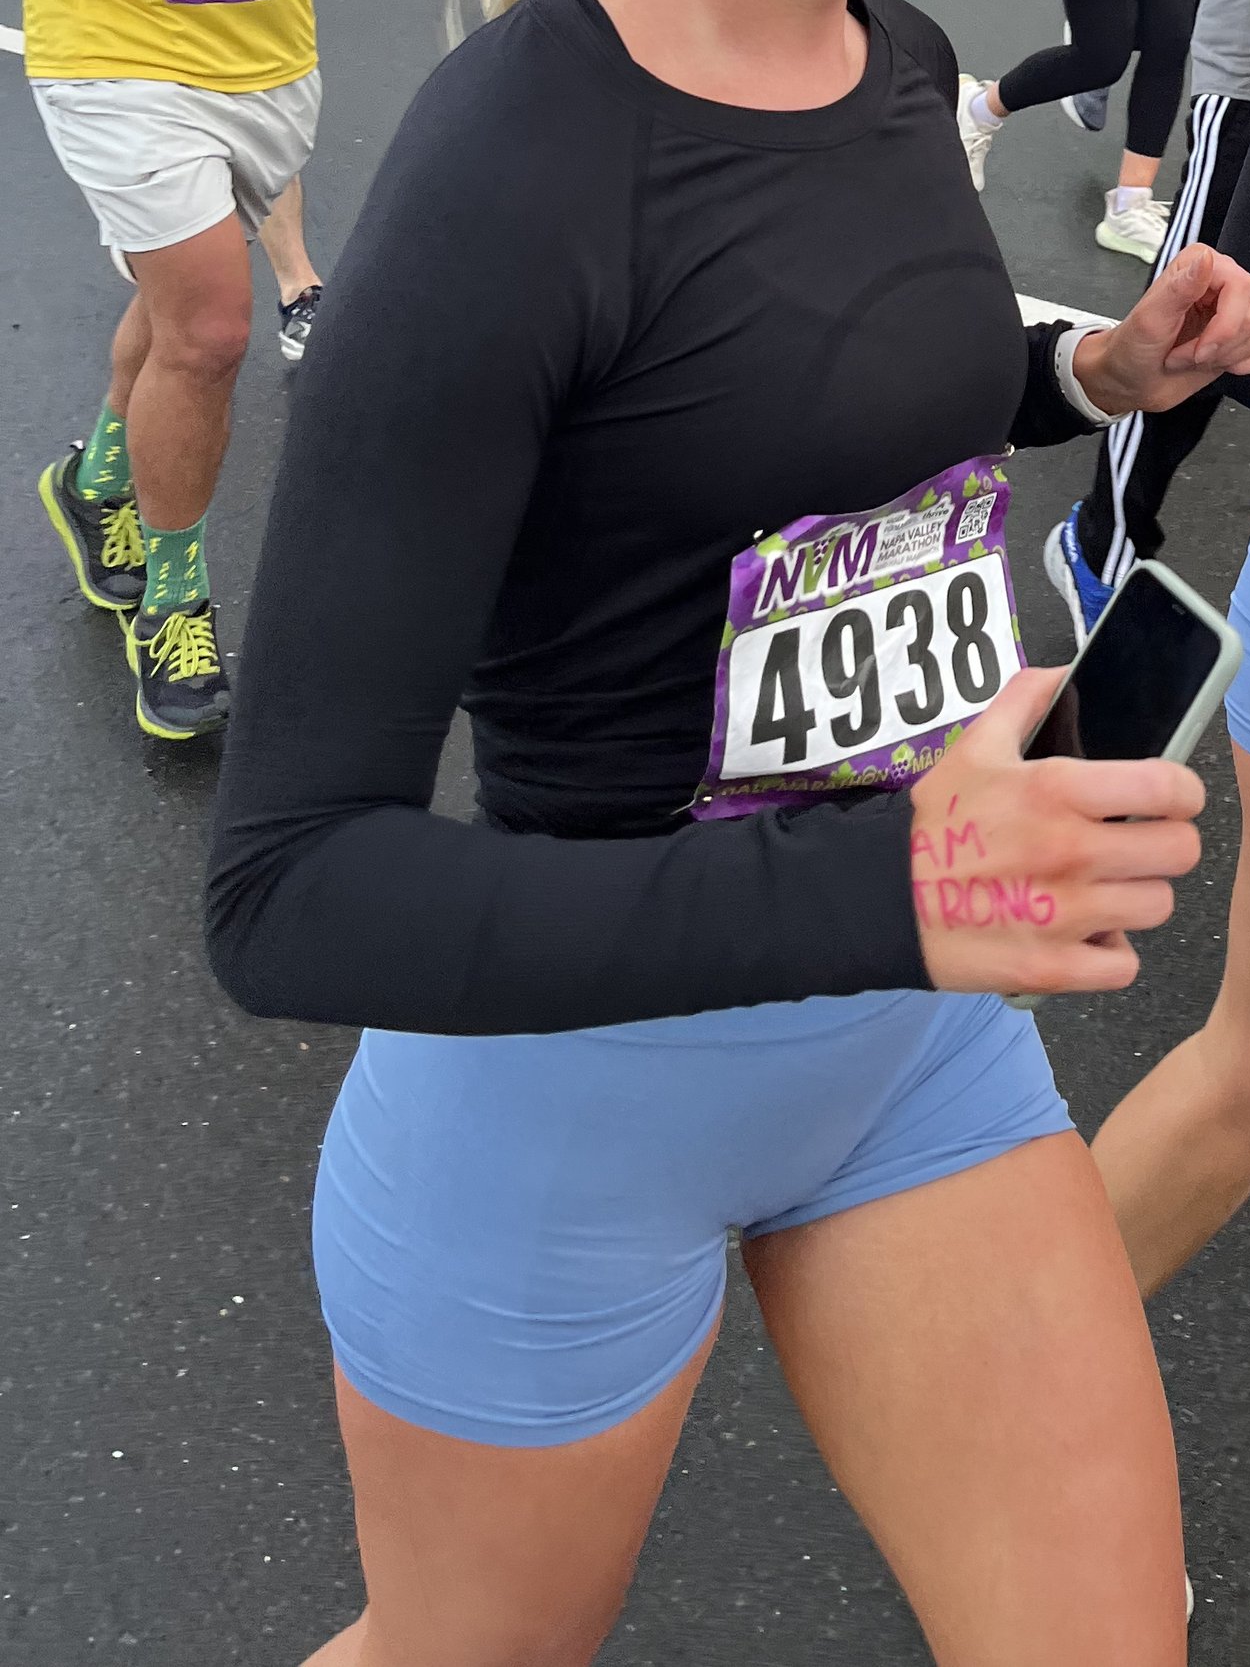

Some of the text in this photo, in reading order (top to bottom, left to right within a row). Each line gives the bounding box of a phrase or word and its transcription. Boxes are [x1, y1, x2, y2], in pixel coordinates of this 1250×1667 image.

[878, 534, 941, 562] MARATHON
[880, 532, 906, 551] NAPA
[908, 520, 945, 540] VALLEY
[756, 521, 881, 615] NVM
[750, 571, 1002, 765] 4938
[912, 744, 951, 775] MAR
[911, 820, 987, 869] AM
[912, 875, 1056, 931] TRONG
